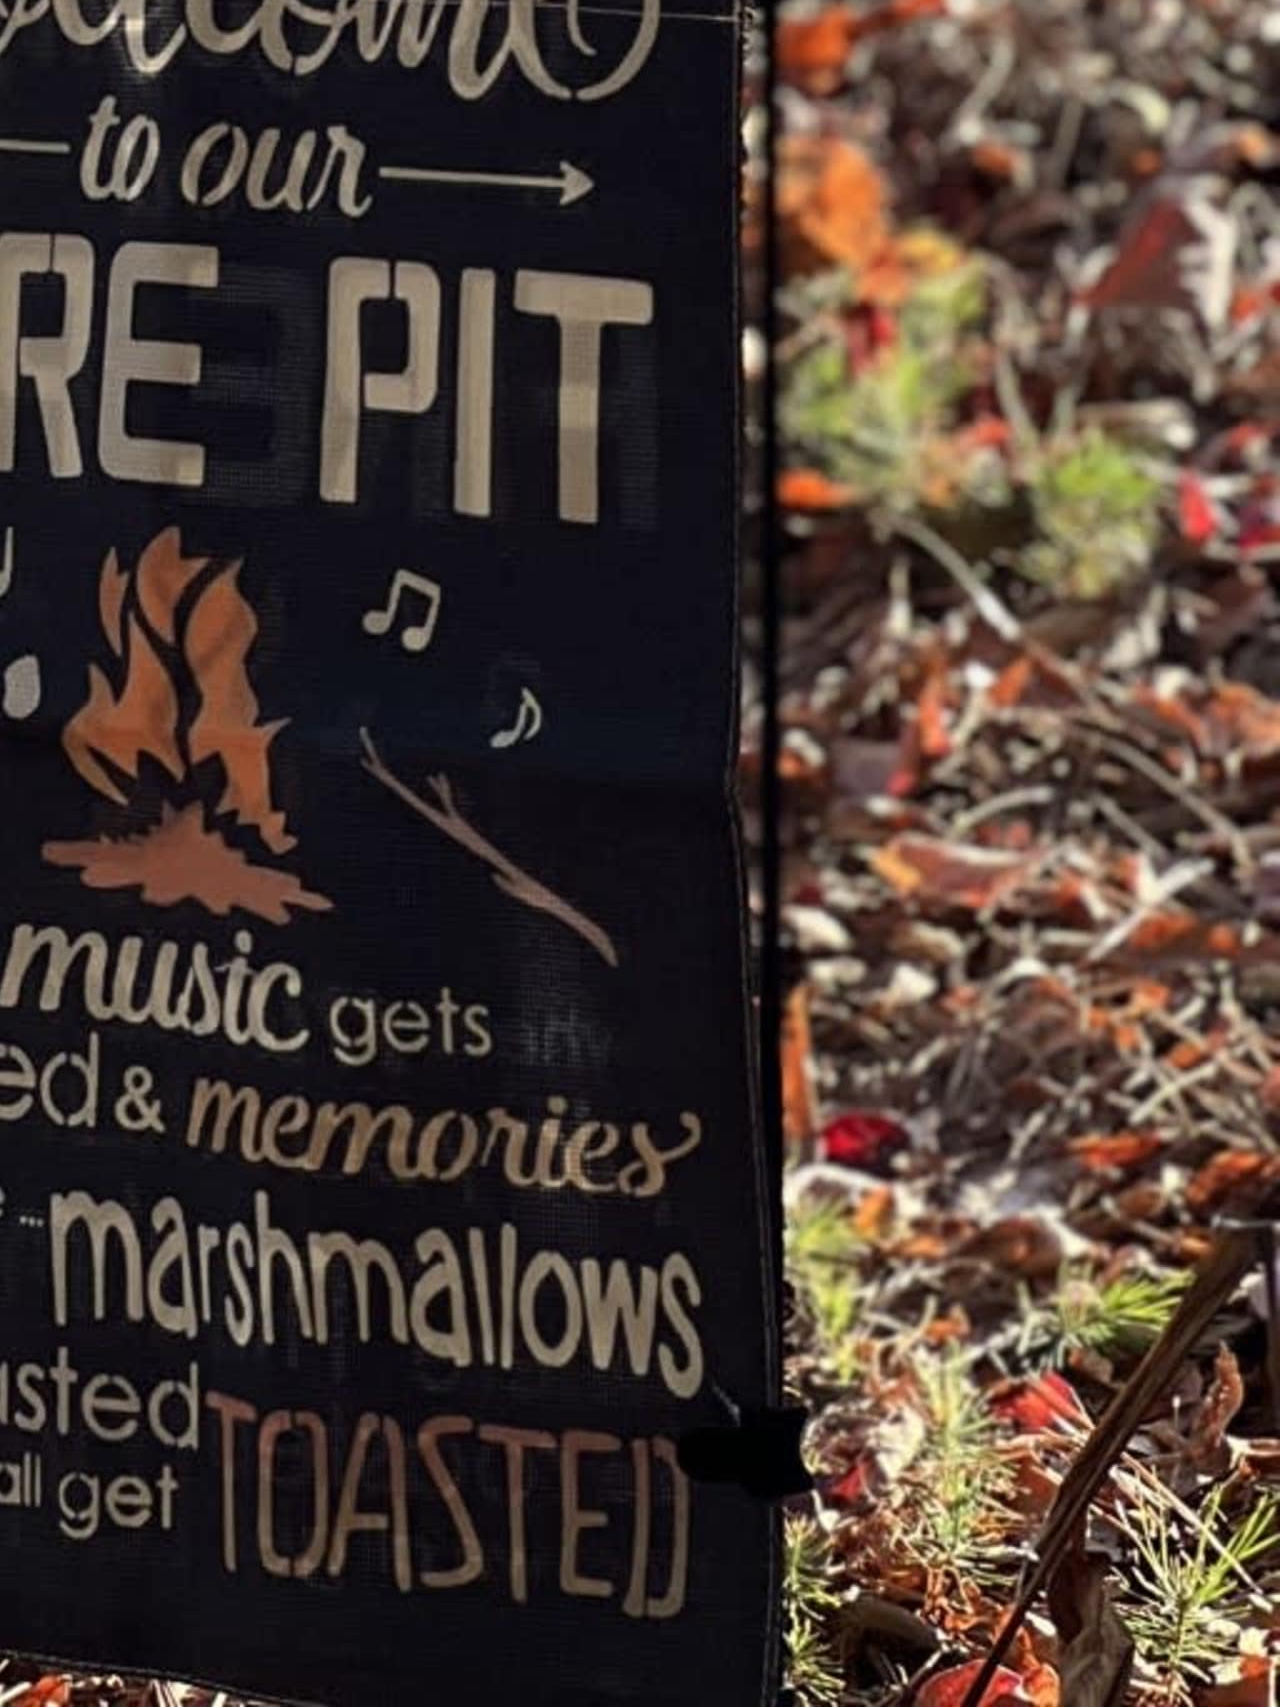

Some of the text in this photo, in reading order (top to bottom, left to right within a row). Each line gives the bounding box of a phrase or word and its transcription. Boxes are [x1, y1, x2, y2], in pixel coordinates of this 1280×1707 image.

[80, 95, 372, 218] to our
[319, 255, 654, 525] PIT
[329, 989, 493, 1067] gets
[115, 1069, 163, 1129] &
[186, 1074, 701, 1198] memories
[50, 1189, 703, 1398] marshmallows
[58, 1463, 178, 1539] get
[206, 1389, 688, 1618] TOASTED
